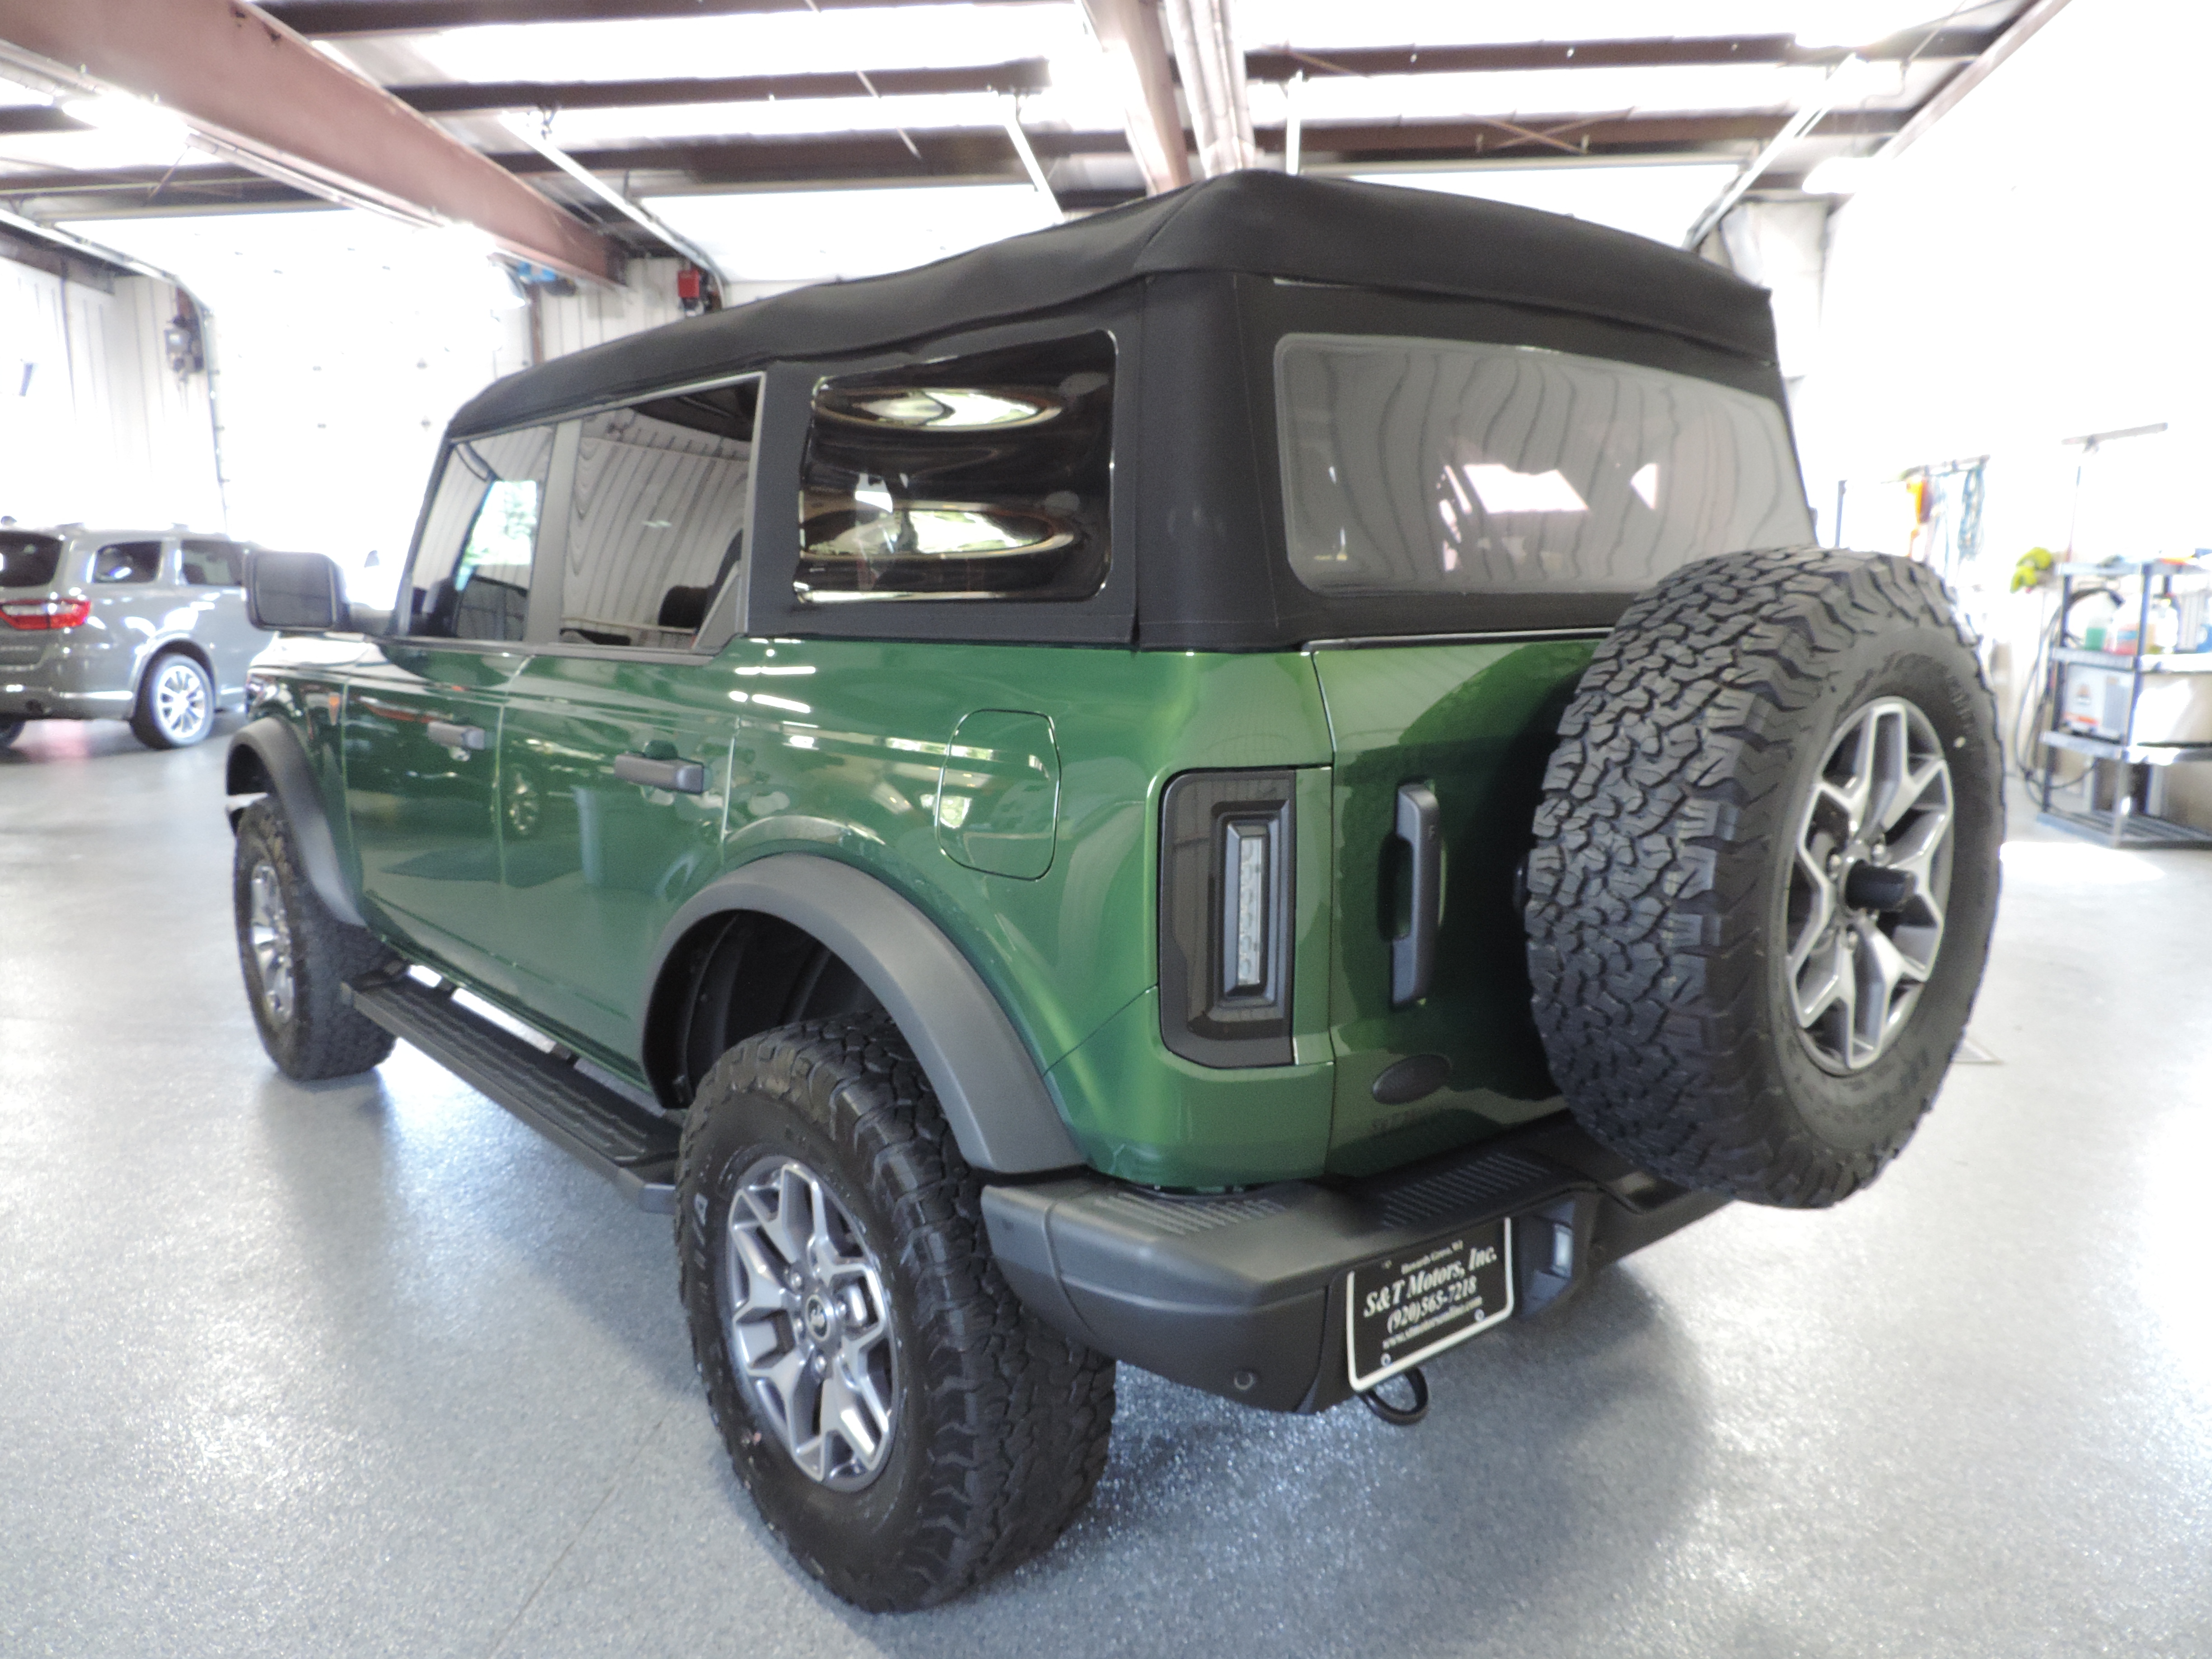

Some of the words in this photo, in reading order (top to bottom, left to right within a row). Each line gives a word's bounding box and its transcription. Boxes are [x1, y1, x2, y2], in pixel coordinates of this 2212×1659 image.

[1363, 1279, 1406, 1317] S&T
[1406, 1260, 1466, 1299] Motors,
[1468, 1246, 1497, 1271] Inc.
